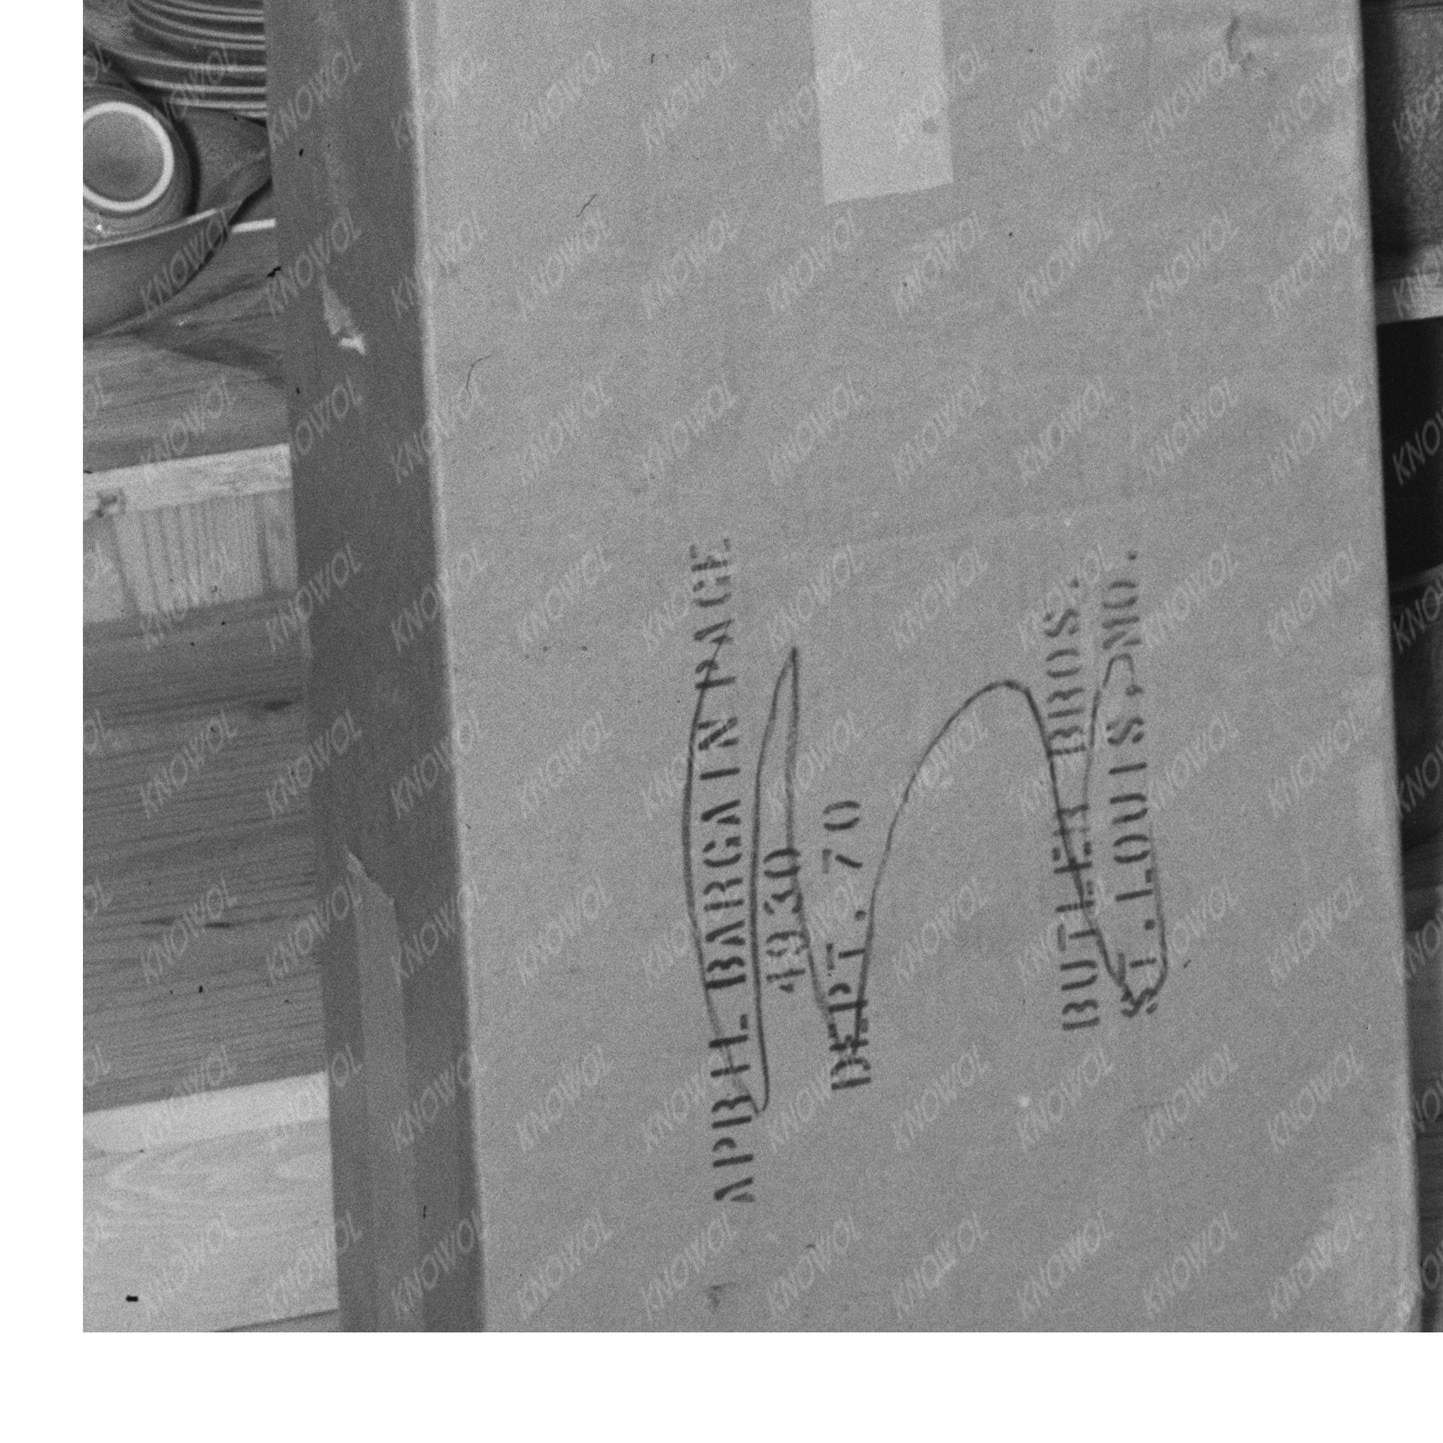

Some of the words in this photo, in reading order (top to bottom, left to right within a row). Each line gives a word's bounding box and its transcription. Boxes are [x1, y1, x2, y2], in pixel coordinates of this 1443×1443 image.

[689, 537, 736, 691] PAGE
[1043, 576, 1087, 759] BROS.
[1102, 549, 1143, 652] MO.
[697, 715, 748, 991] BARGAIN
[762, 847, 806, 994] 4930
[821, 799, 863, 875] 70
[1051, 801, 1101, 1031] BUTLER
[825, 907, 872, 1091] DEPT.
[709, 1013, 755, 1203] APRIL
